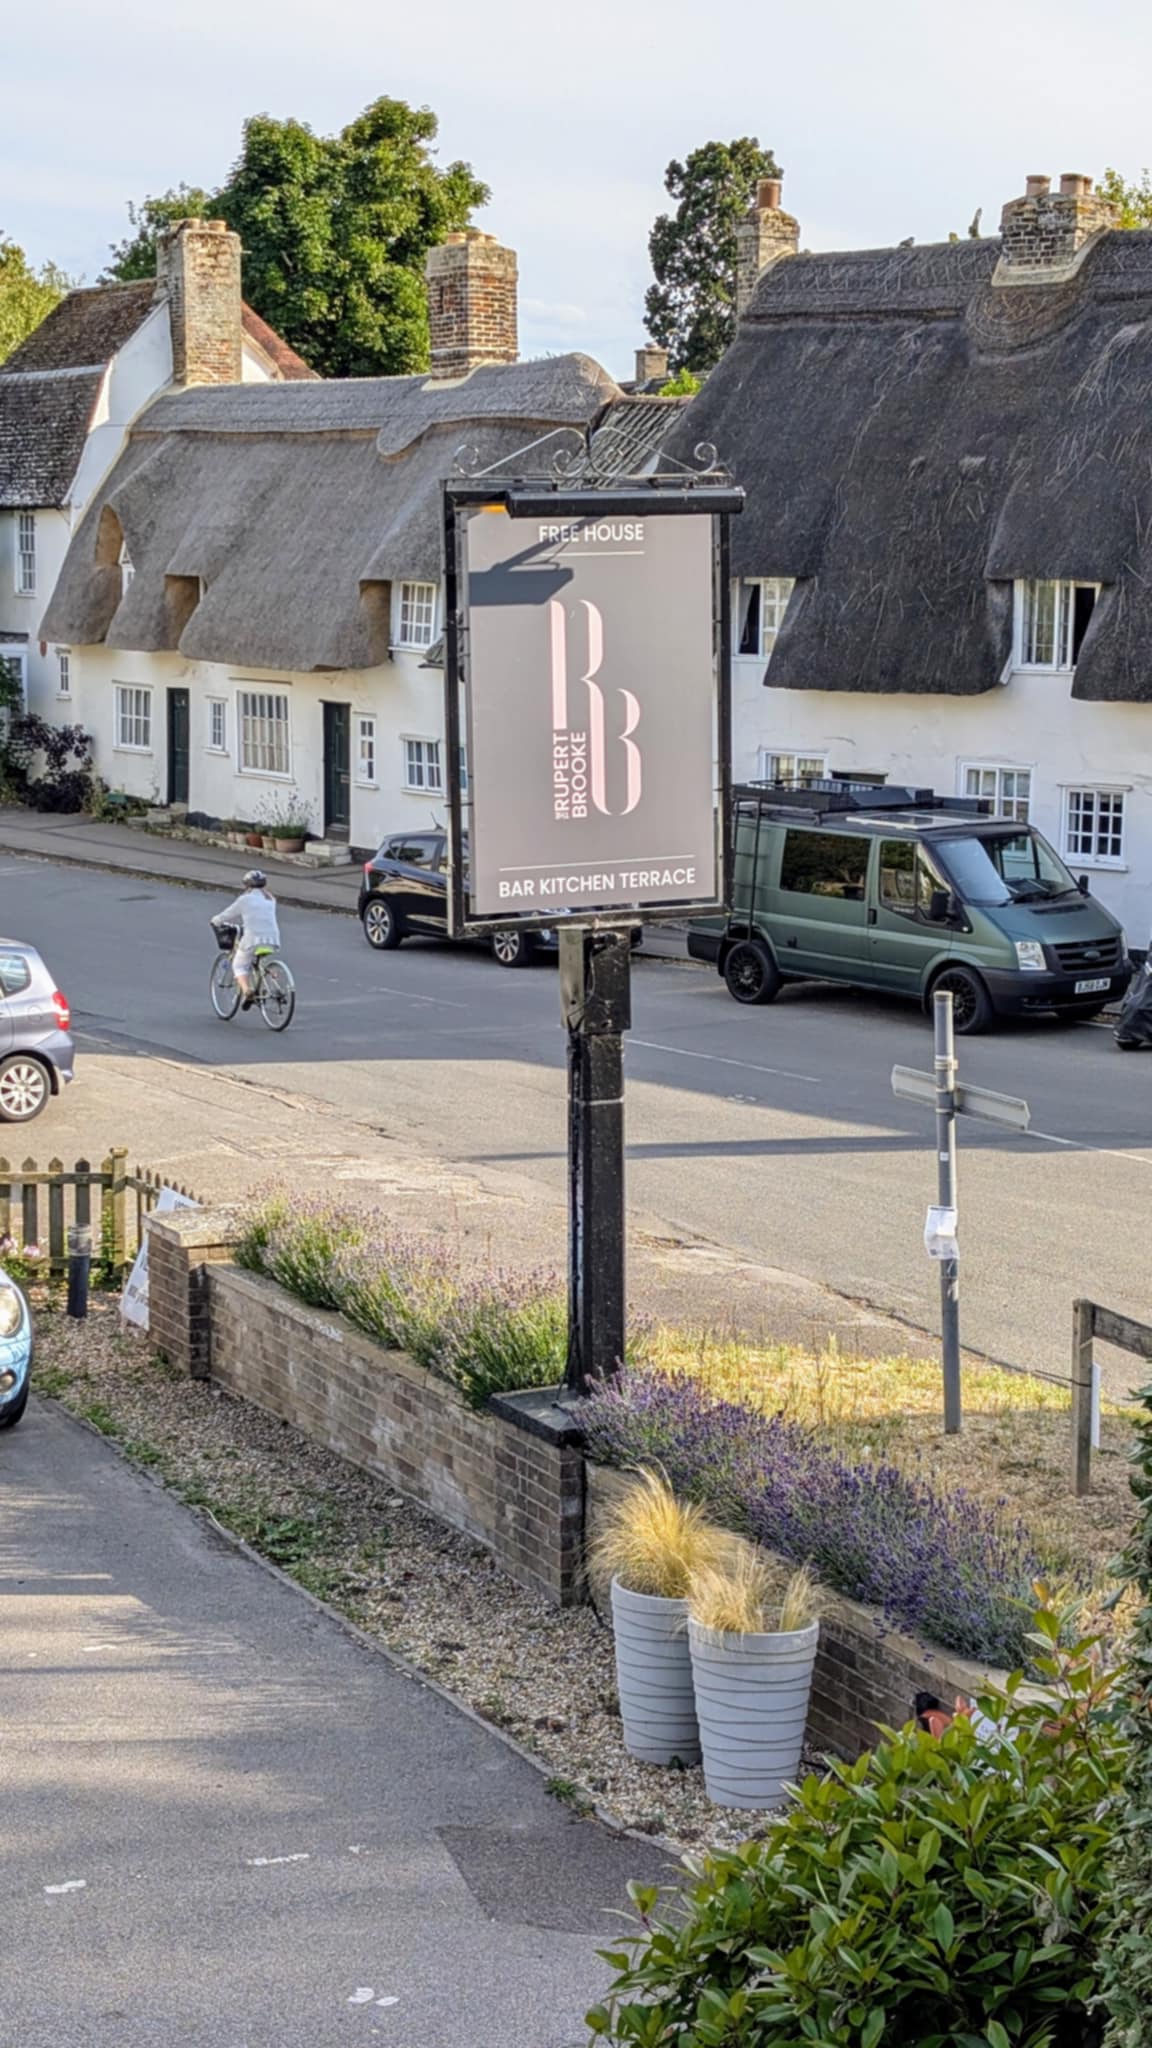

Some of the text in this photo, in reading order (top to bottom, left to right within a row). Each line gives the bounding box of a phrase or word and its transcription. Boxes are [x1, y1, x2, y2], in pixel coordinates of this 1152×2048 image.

[539, 523, 644, 543] FREE HOUSE
[553, 733, 570, 812] RUPERT
[570, 732, 588, 818] BROOKE
[499, 867, 696, 898] BAR KITCHEN TERRACE
